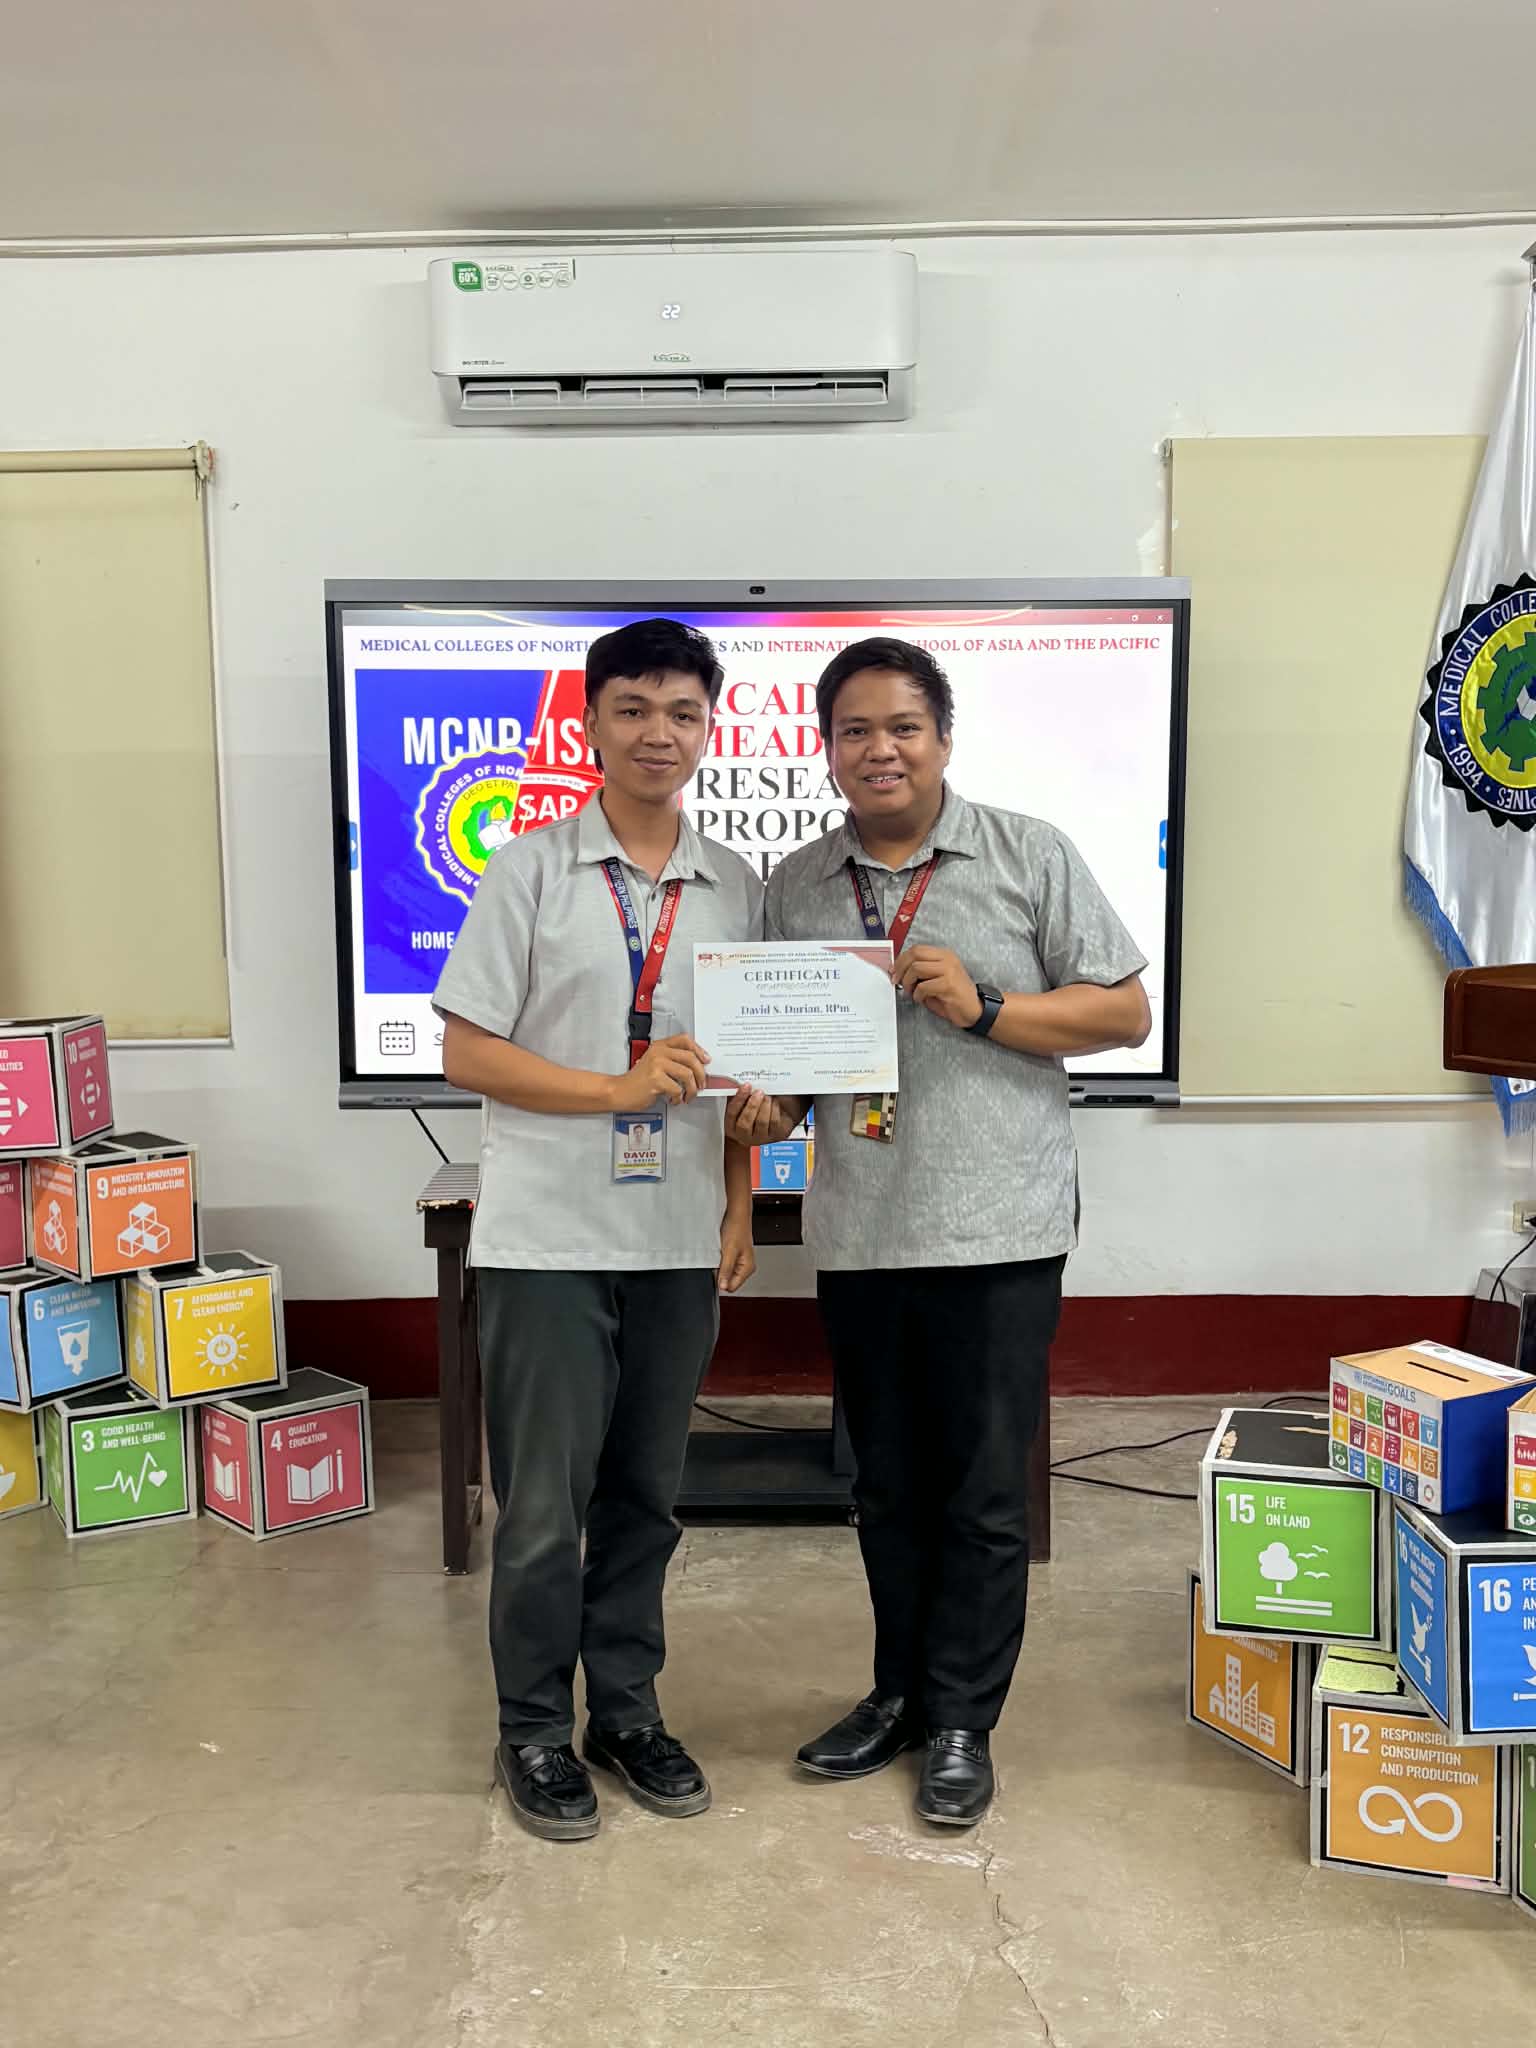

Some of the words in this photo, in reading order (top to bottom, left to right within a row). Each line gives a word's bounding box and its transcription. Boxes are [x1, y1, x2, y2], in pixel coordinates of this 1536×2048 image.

[662, 304, 680, 319] 22
[360, 639, 431, 651] MEDICAL
[434, 639, 514, 652] COLLEGES
[518, 640, 538, 651] OF
[541, 640, 594, 652] NORT
[731, 641, 764, 652] AND
[768, 640, 849, 652] INTERNATI
[965, 639, 984, 651] OF
[987, 639, 1023, 651] ASIA
[1027, 638, 1061, 650] AND
[1064, 638, 1095, 650] THE
[1099, 637, 1160, 650] PACIFIC
[1440, 628, 1488, 716] MEDICAL
[1490, 592, 1536, 629] COLLE
[474, 765, 491, 778] OF
[1449, 743, 1485, 789] 1994
[695, 767, 843, 800] RESEA
[435, 773, 473, 831] COLLEGES
[512, 795, 578, 822] SAP
[694, 808, 847, 841] PROPO
[437, 835, 475, 885] MEDICAL
[411, 931, 455, 949] HOME
[744, 969, 841, 982] CERTIFICATE
[740, 1004, 770, 1016] David
[68, 1041, 78, 1065] 10
[623, 1151, 656, 1159] DAVID
[96, 1177, 109, 1200] 9
[33, 1299, 45, 1321] 6
[173, 1298, 185, 1321] 7
[1387, 1383, 1416, 1403] GOALS
[101, 1425, 124, 1436] GOOD
[125, 1420, 154, 1433] HEALTH
[288, 1421, 318, 1437] QUALITY
[81, 1430, 95, 1452] 3
[102, 1438, 119, 1449] AND
[120, 1431, 166, 1447] WELL-BEING
[270, 1429, 283, 1452] 4
[289, 1432, 328, 1449] EDUCATION
[1226, 1493, 1256, 1524] 15
[1265, 1495, 1287, 1510] LIFE
[1265, 1513, 1281, 1527] ON
[1283, 1514, 1311, 1529] LAND
[1398, 1527, 1409, 1564] 16
[1478, 1578, 1512, 1613] 16
[1522, 1577, 1536, 1592] PE
[1522, 1596, 1536, 1611] AN
[1523, 1615, 1536, 1631] IN
[1337, 1722, 1371, 1754] 12
[1380, 1727, 1450, 1746] RESPONSIBL
[1380, 1744, 1462, 1767] CONSUMPTION
[1380, 1762, 1403, 1777] AND
[1406, 1765, 1480, 1785] PRODUCTION
[1527, 1755, 1536, 1788] 1
